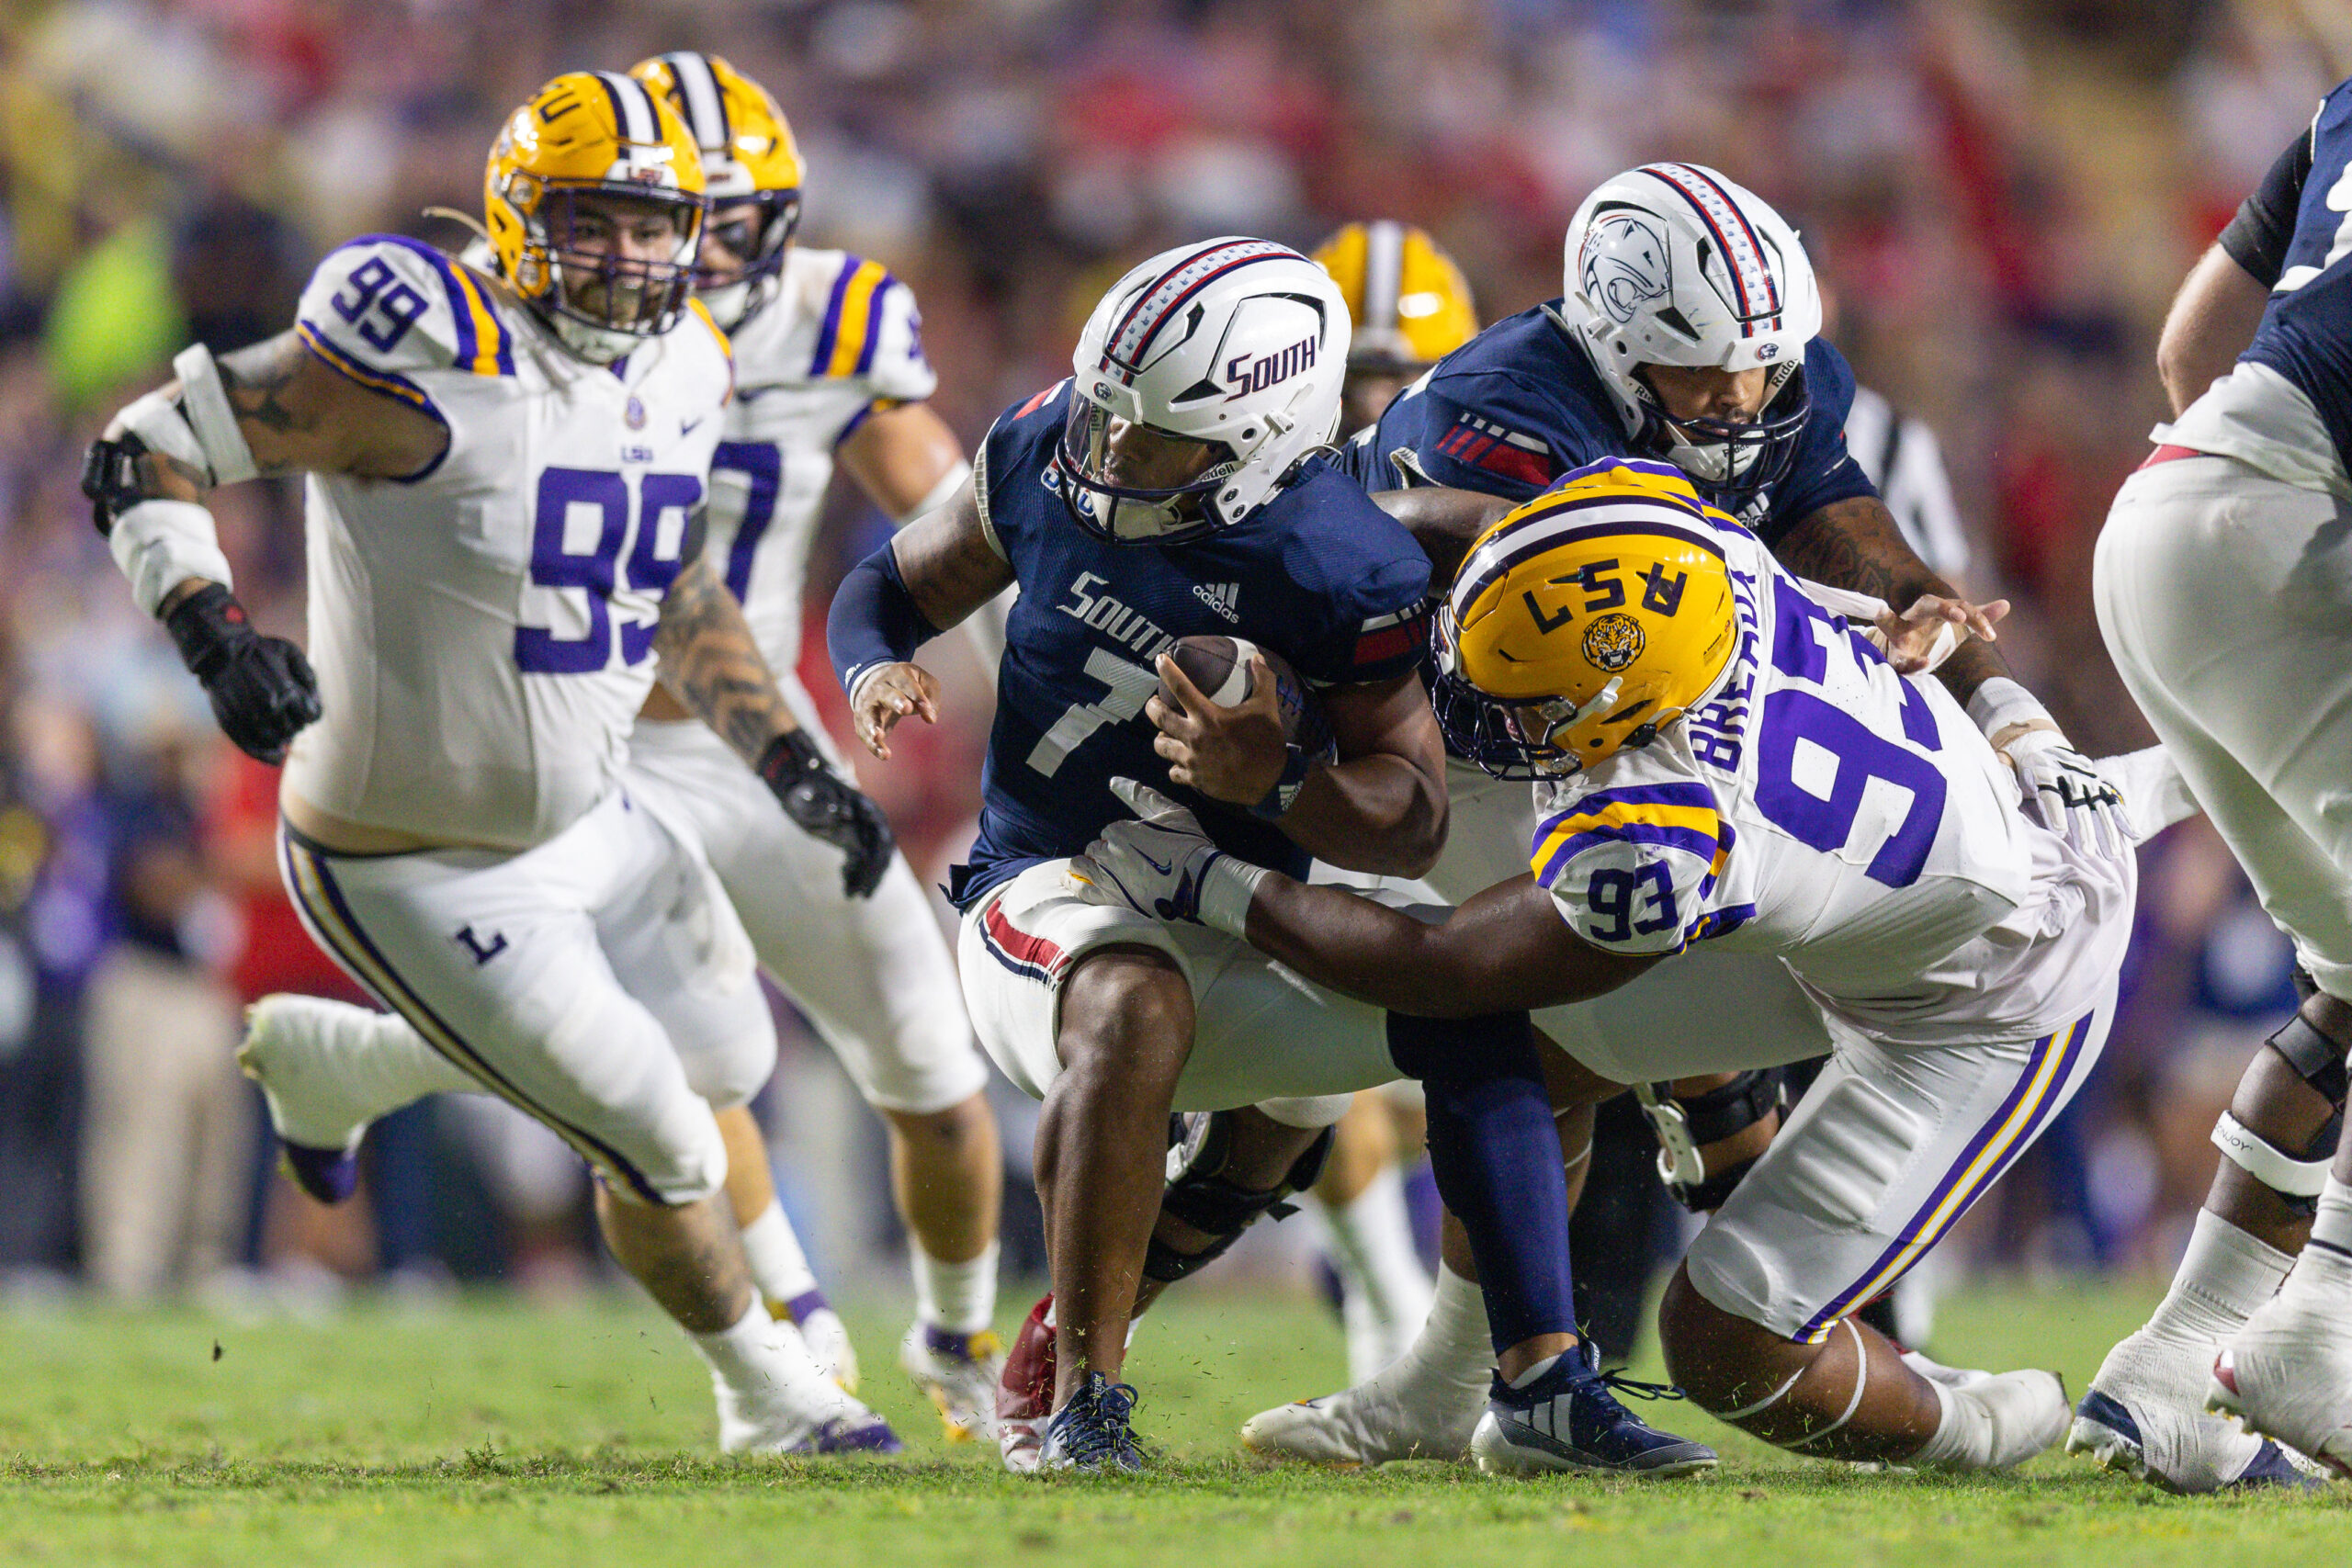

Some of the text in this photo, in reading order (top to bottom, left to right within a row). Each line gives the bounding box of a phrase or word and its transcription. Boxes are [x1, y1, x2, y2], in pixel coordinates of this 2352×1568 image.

[331, 257, 429, 355] 99
[1225, 334, 1317, 402] SOUTH
[514, 466, 702, 673] 99
[1193, 584, 1240, 625] adidas
[1025, 646, 1160, 779] 7
[1754, 572, 1948, 888] 93
[457, 925, 508, 964] L
[1588, 859, 1679, 942] 93
